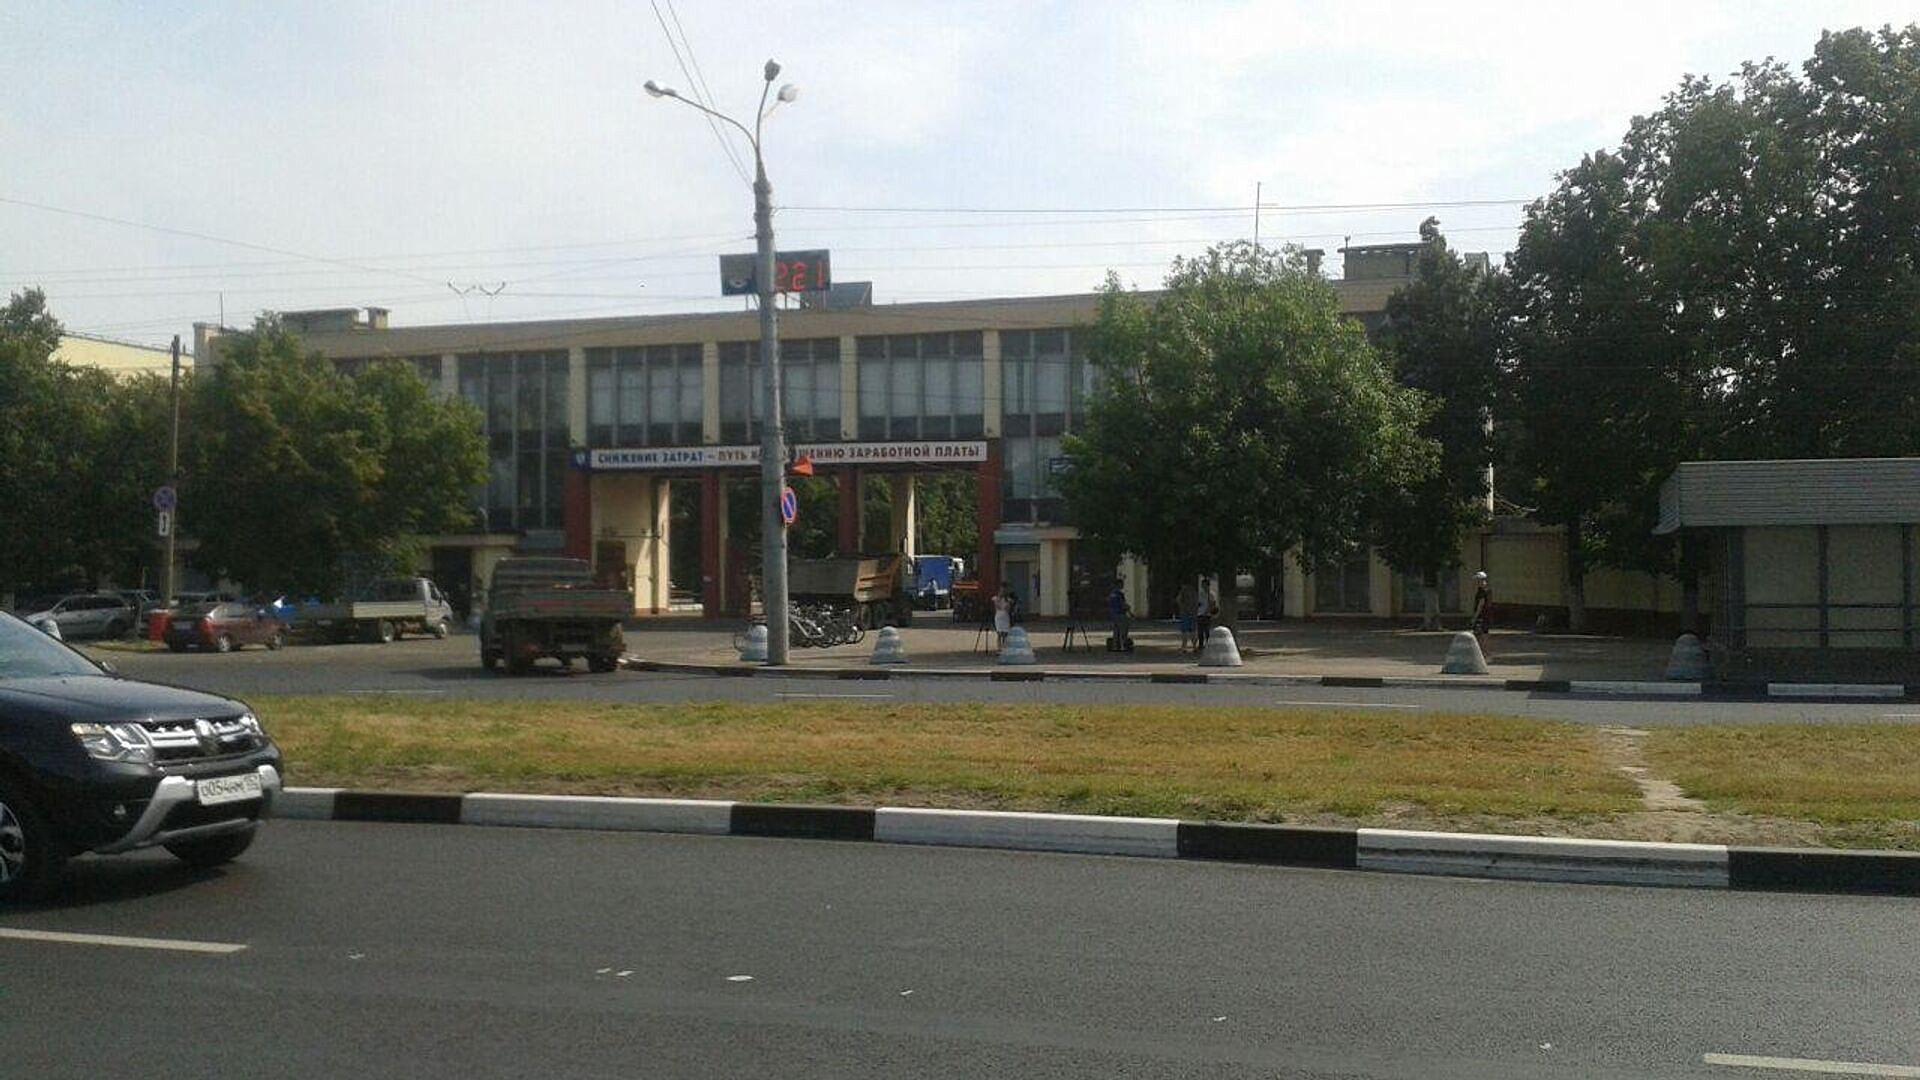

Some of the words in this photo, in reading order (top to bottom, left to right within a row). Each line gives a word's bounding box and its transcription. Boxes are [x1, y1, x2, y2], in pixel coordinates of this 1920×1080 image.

[598, 451, 657, 464] СНИЖЕНИЕ
[662, 450, 703, 463] ЗАТРАТ
[718, 449, 748, 461] ПУТЬ
[849, 444, 930, 458] ЗАРАБОТНОЙ
[935, 444, 980, 457] ПЛАТЫ
